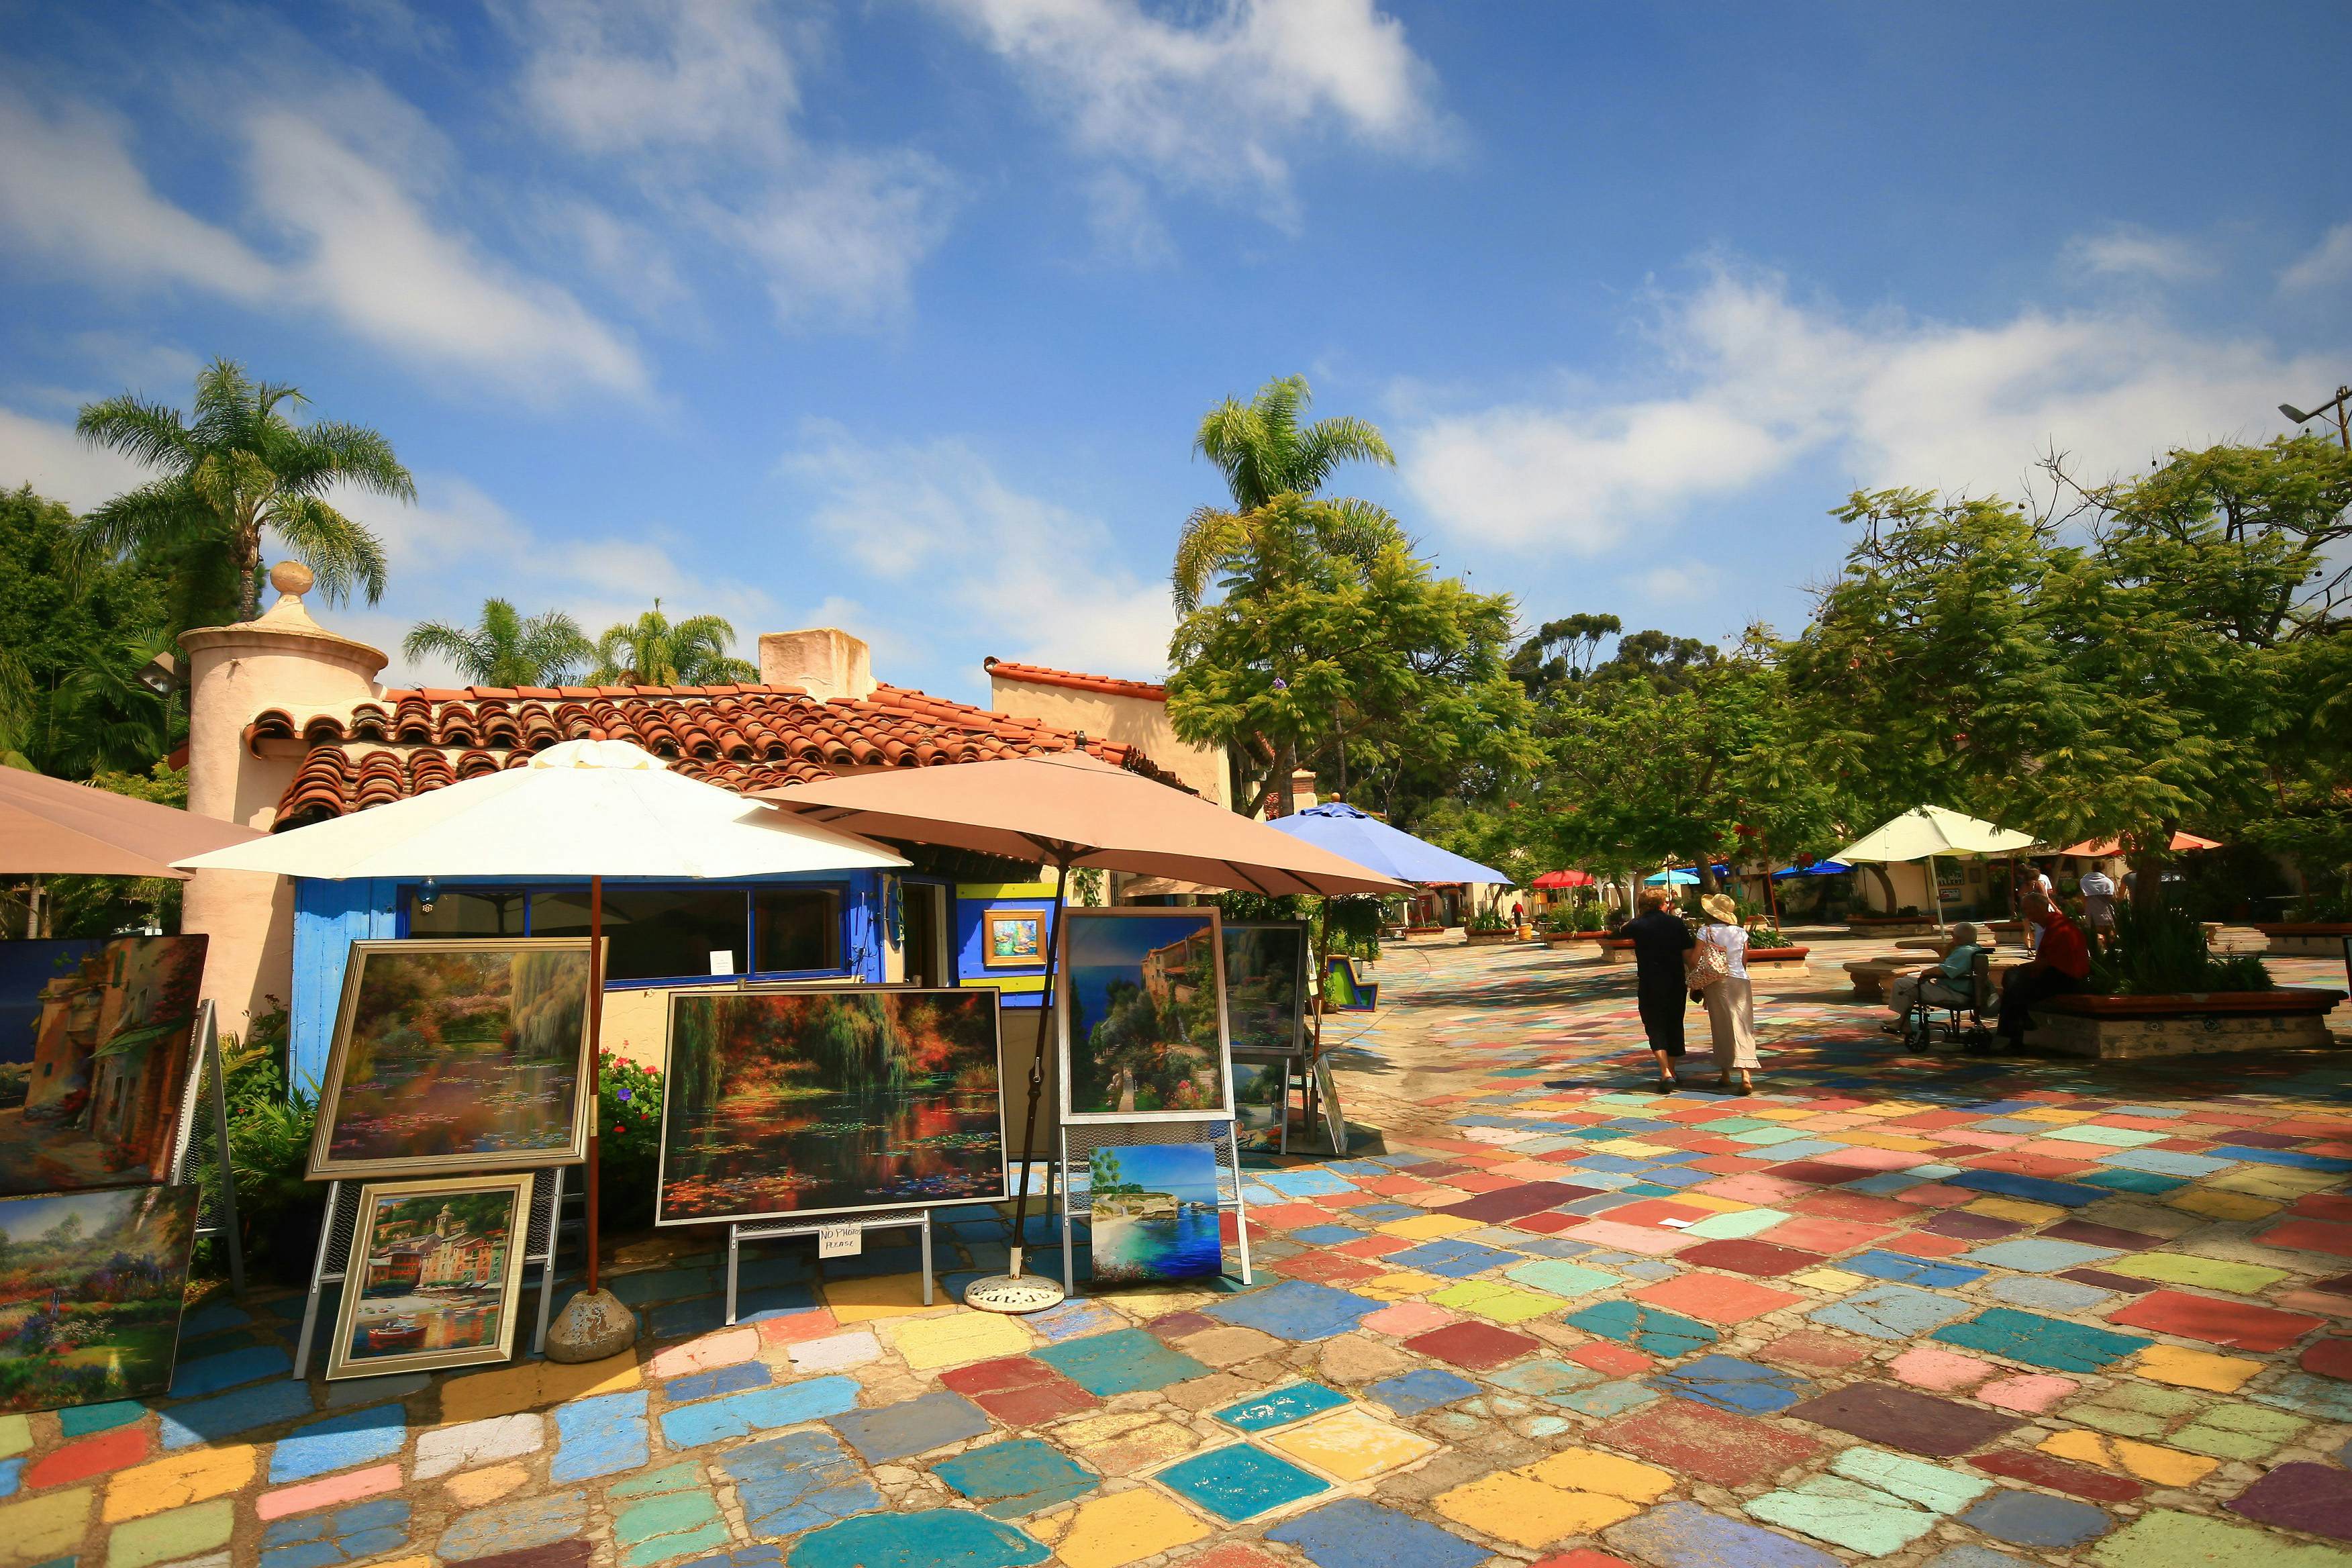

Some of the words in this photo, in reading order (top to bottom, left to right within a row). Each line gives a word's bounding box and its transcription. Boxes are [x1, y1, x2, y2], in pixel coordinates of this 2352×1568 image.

[821, 1230, 833, 1240] NO
[836, 1228, 862, 1237] PHOTOS
[826, 1240, 853, 1250] PLEASE
